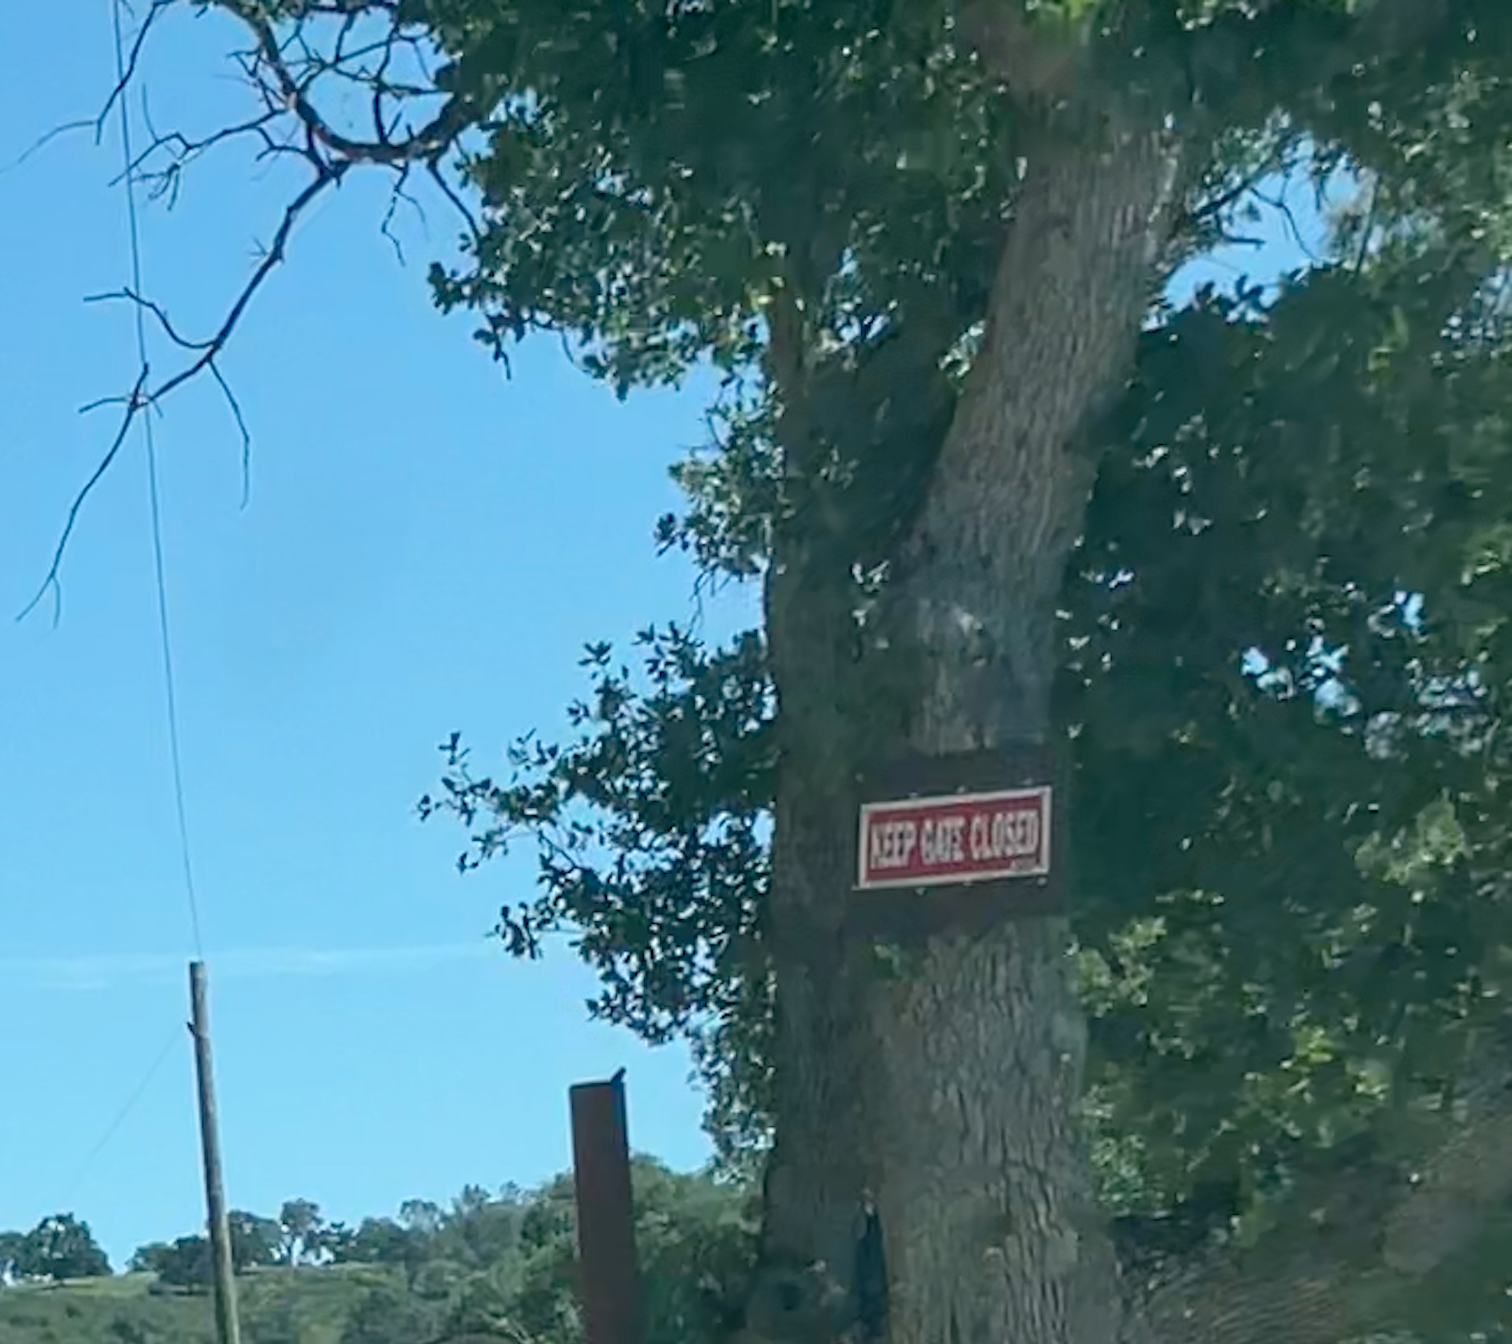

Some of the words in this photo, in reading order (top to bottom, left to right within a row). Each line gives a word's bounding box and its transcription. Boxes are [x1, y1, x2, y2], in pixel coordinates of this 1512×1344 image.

[870, 822, 916, 869] KEEP
[921, 817, 965, 865] GATE
[970, 810, 1038, 860] CLOSED
